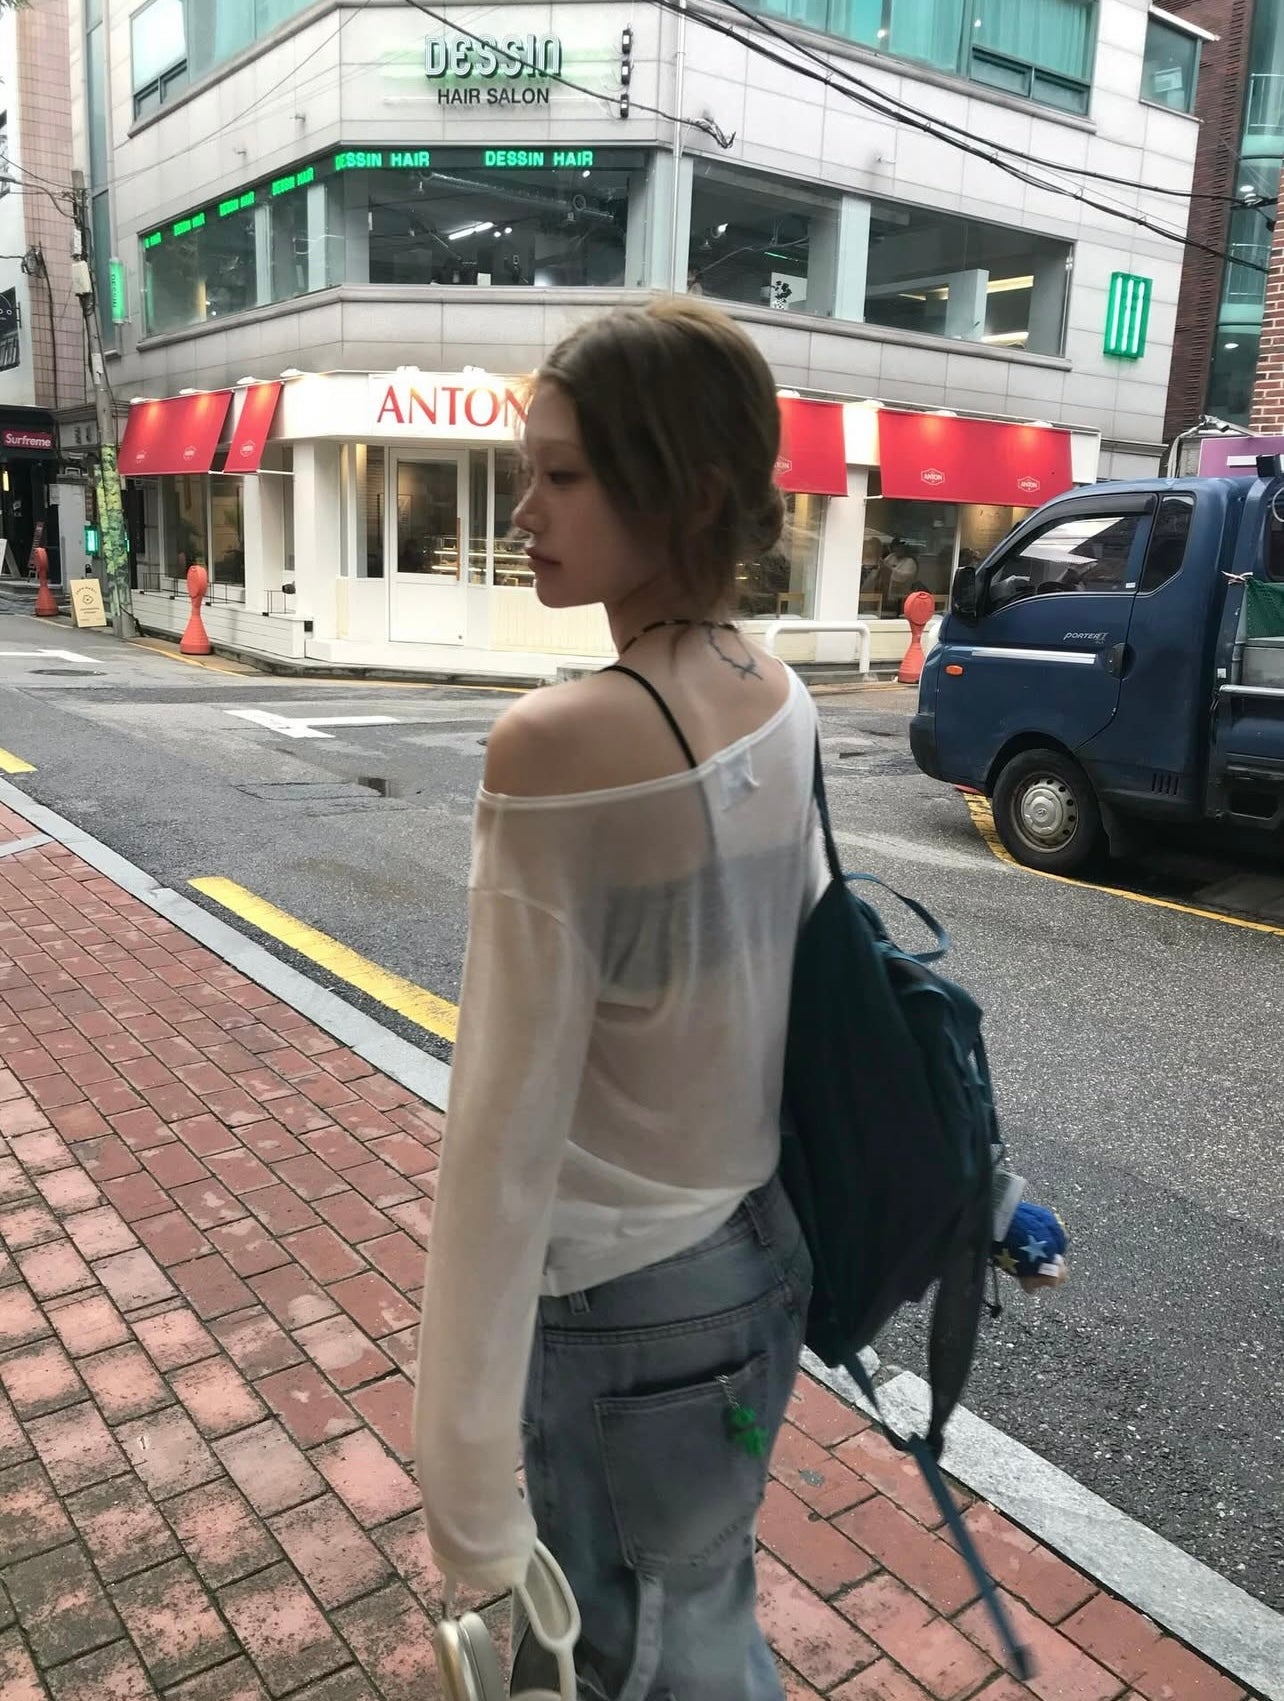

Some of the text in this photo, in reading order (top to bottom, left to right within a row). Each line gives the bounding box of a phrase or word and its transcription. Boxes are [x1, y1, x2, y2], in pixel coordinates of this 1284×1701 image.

[437, 87, 550, 104] HAIR SALON
[391, 151, 430, 167] HAIR
[485, 150, 593, 166] DESSIN HAIR
[6, 433, 51, 447] Surfreme
